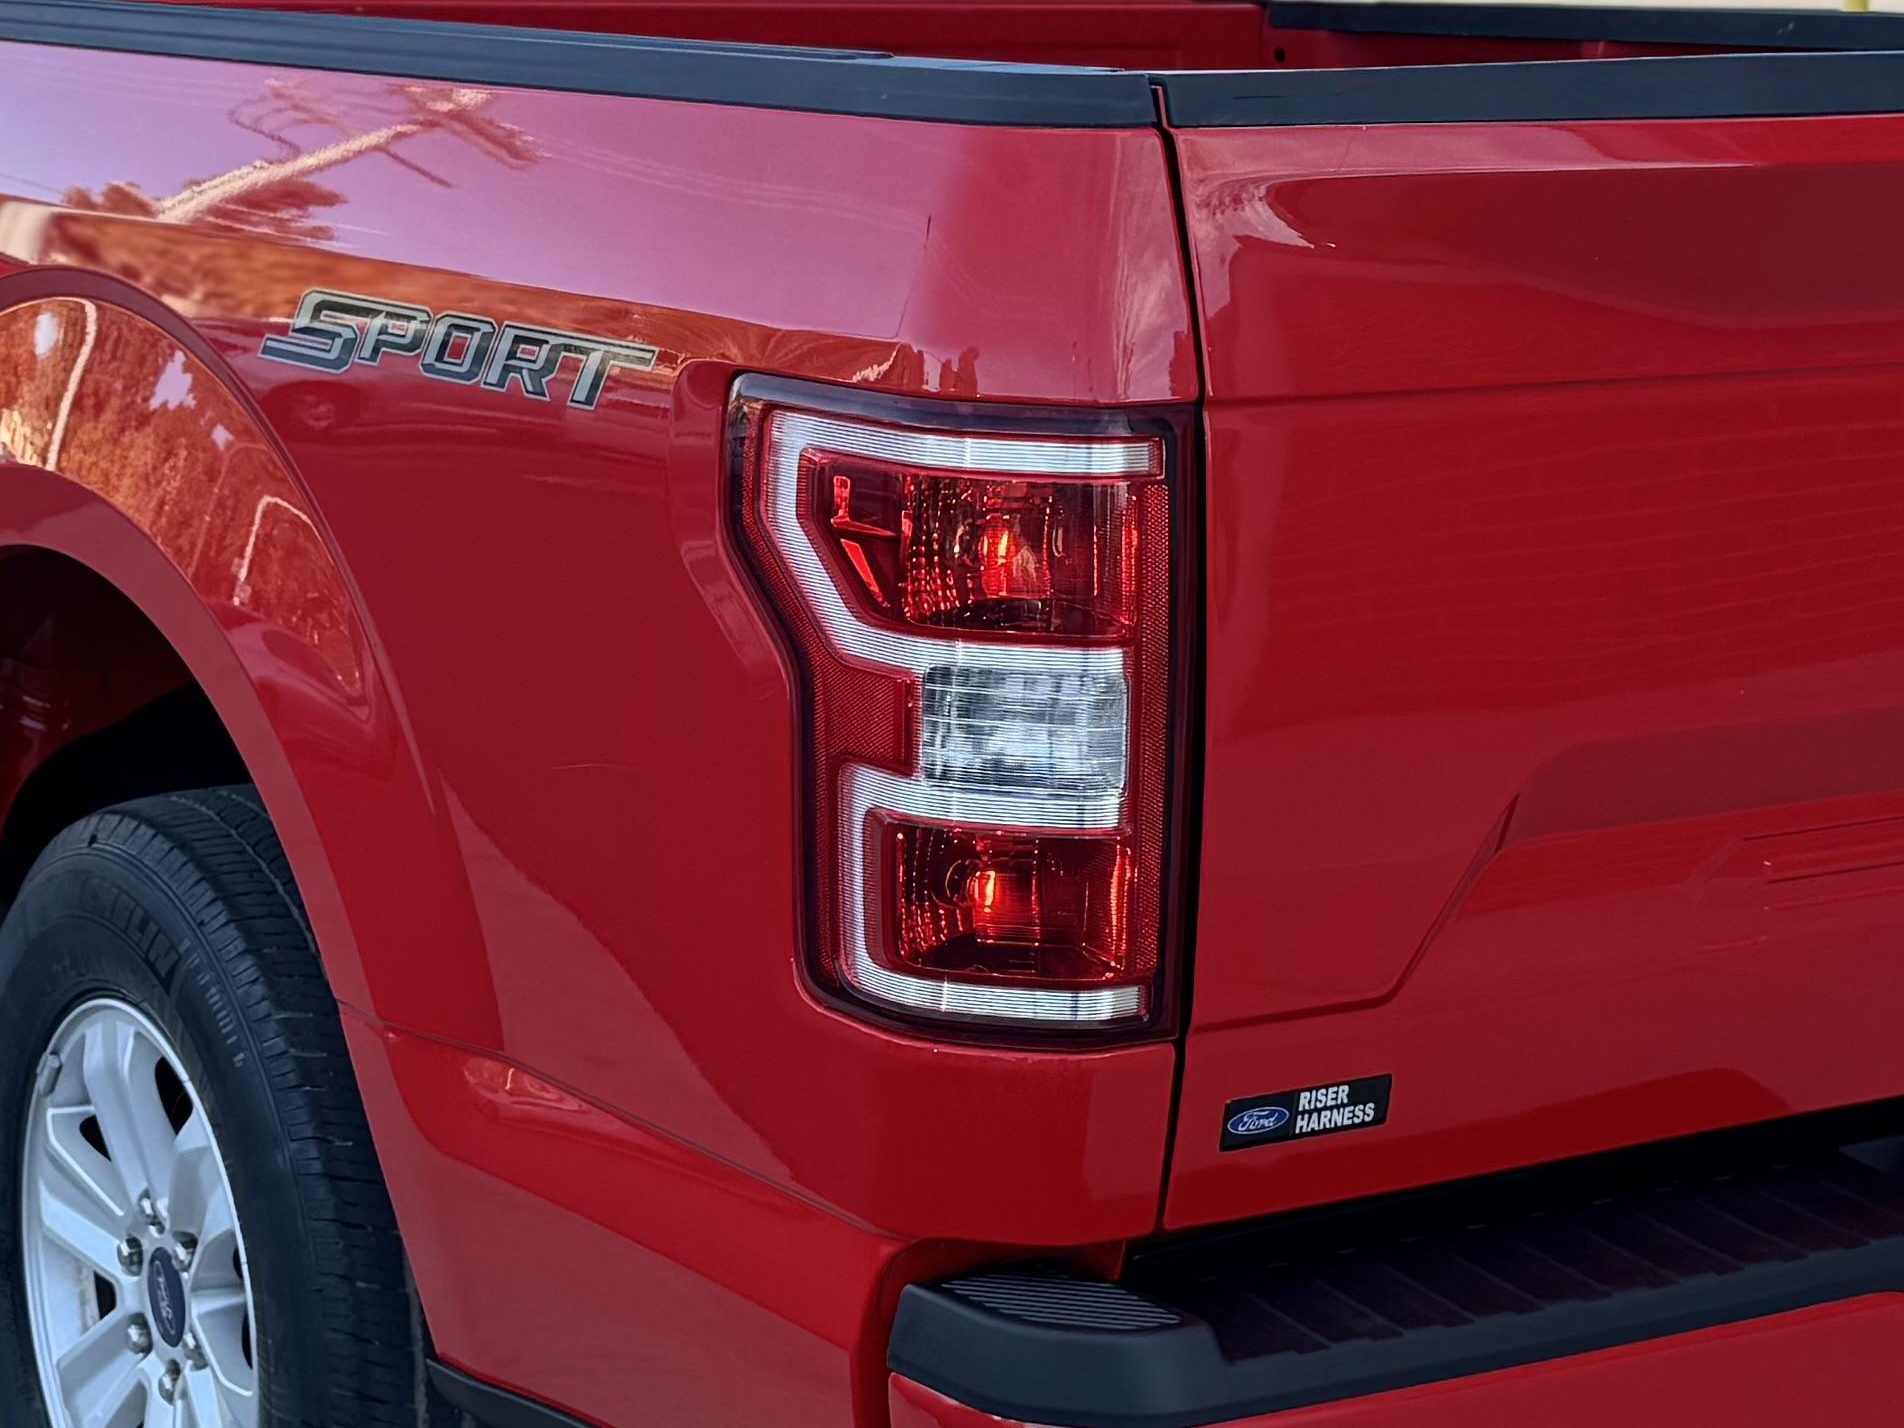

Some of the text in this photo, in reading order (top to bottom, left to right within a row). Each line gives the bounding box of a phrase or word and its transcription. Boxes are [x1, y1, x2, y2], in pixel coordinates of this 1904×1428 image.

[258, 288, 660, 410] SPORT
[1298, 1084, 1350, 1112] RISER
[1238, 1110, 1279, 1132] Ford
[1295, 1103, 1375, 1133] HARNESS
